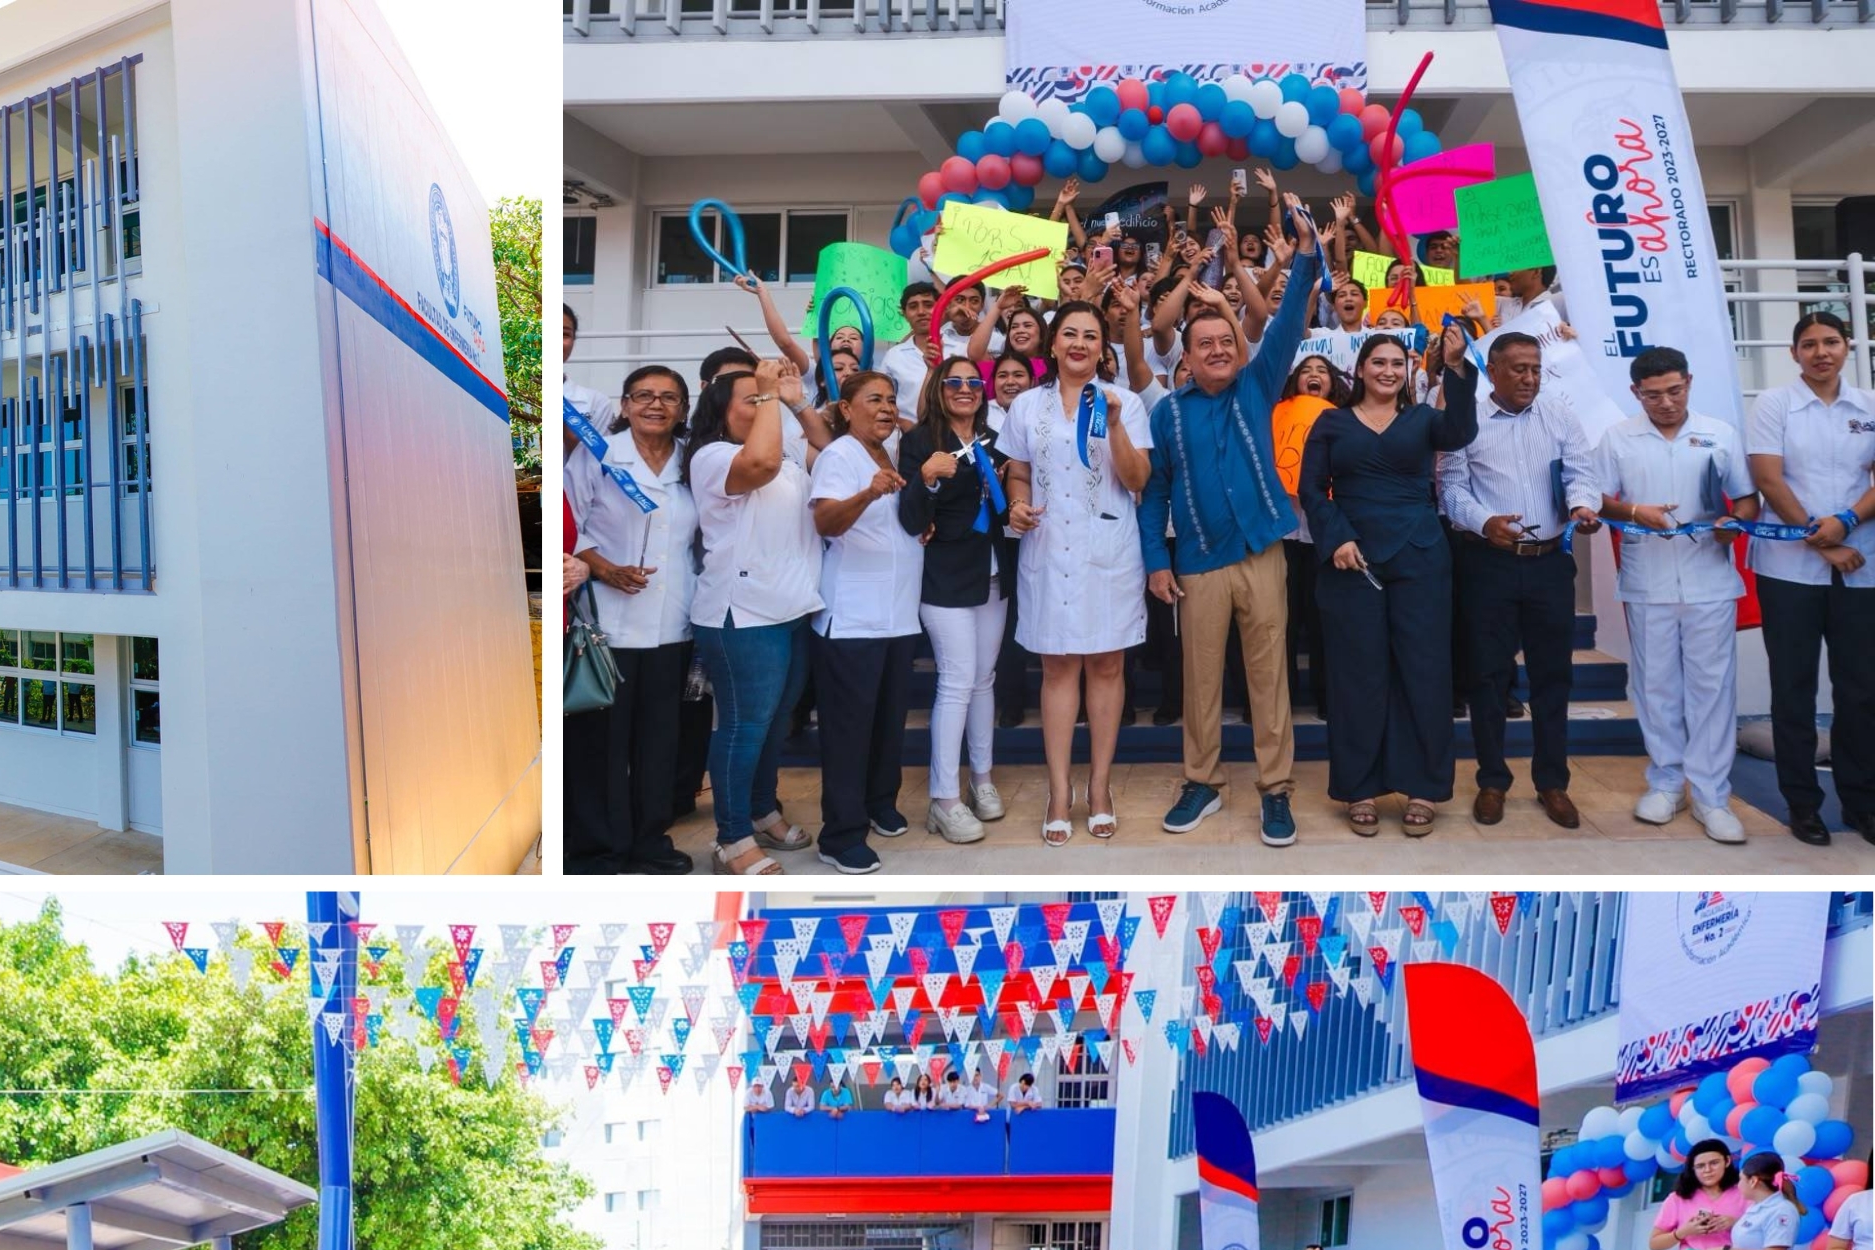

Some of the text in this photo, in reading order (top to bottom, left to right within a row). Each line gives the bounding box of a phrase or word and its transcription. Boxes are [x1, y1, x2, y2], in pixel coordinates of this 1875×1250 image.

[1614, 118, 1671, 252] ahora
[1652, 114, 1698, 279] RECTORADO 2023-2027
[1584, 154, 1656, 358] FUTURO
[1642, 255, 1662, 283] ES
[1604, 339, 1619, 357] EL
[1518, 1184, 1529, 1244] 2023-2027
